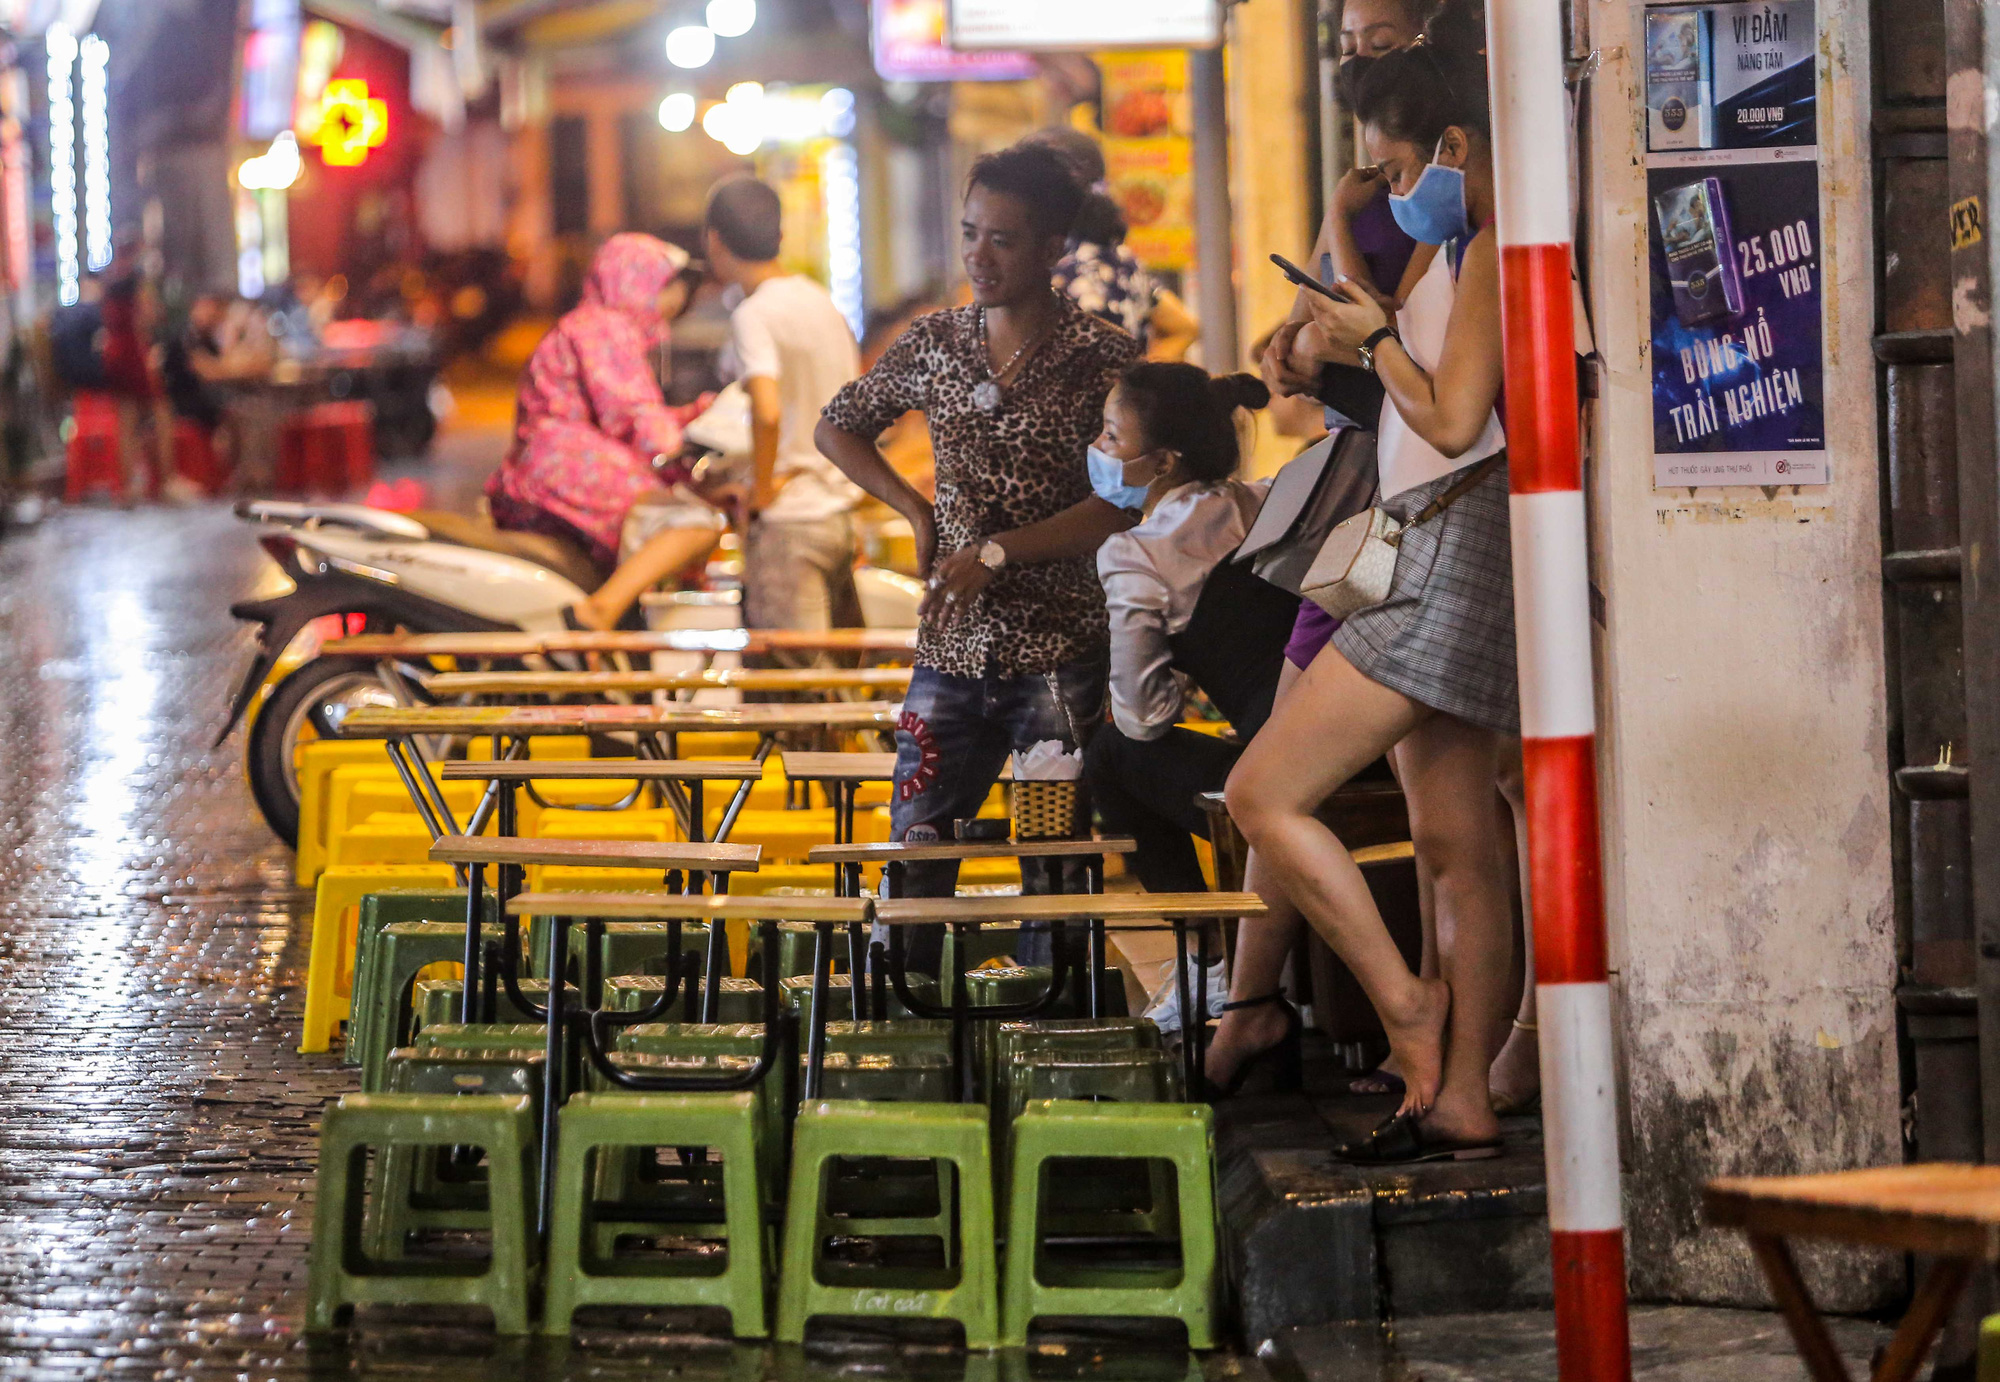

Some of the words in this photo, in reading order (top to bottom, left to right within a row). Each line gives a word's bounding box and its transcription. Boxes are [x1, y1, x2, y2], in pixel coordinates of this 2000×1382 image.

[1732, 15, 1748, 47] VỊ
[1737, 108, 1766, 122] 20.000
[1738, 220, 1812, 278] 25.000
[1743, 306, 1774, 363] NỔ
[1669, 388, 1719, 443] TRẢI
[1724, 367, 1803, 427] NGHIỆM
